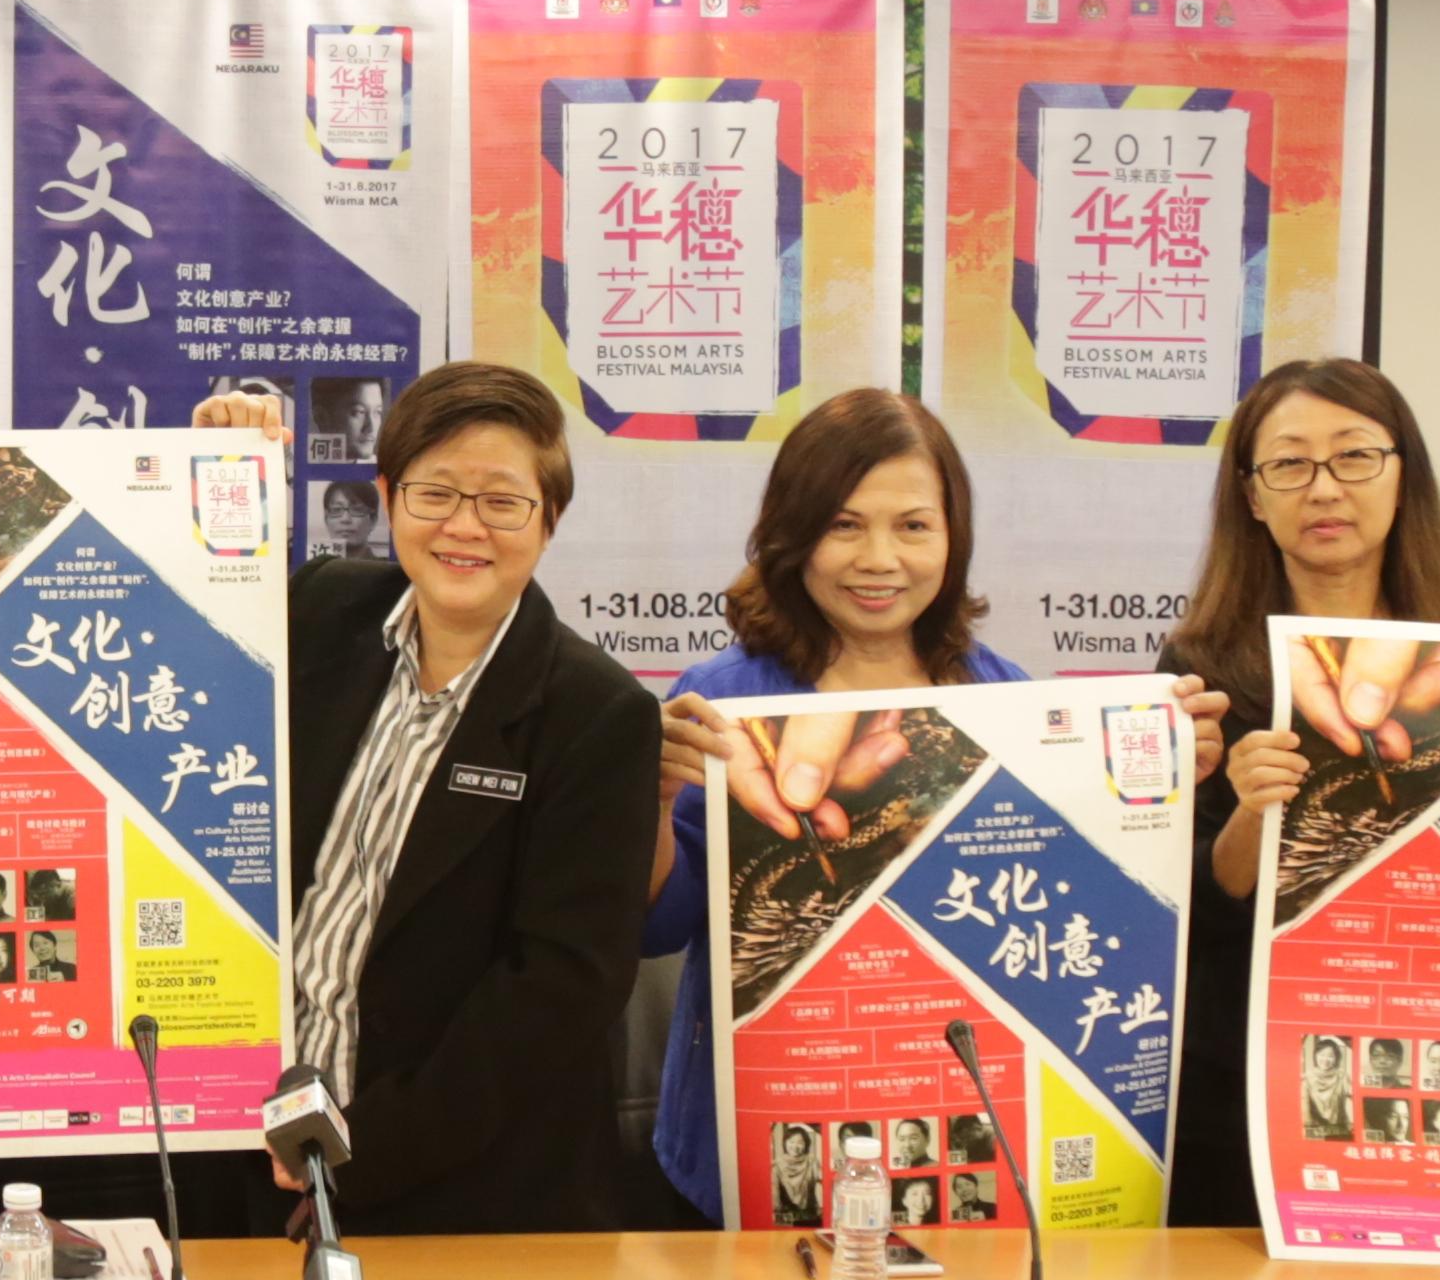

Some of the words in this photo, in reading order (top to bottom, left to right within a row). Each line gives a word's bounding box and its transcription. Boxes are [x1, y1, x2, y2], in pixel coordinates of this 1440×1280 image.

[328, 44, 391, 58] 2017
[216, 64, 280, 74] NEGARAKU
[329, 65, 388, 99] 华穗
[328, 100, 388, 124] 艺术节
[598, 127, 747, 159] 2017
[1071, 133, 1217, 167] 2017
[641, 162, 701, 178] 马来西亚
[1114, 169, 1173, 184] 马来西亚
[327, 182, 397, 192] 1-31.8.2017
[324, 195, 365, 206] Wisma
[369, 196, 398, 207] MCA
[598, 177, 744, 261] 华穗
[1070, 185, 1211, 268] 华穗
[176, 262, 212, 282] 何谓
[176, 290, 292, 308] 文化创意产业?
[597, 266, 744, 324] 艺术节
[1067, 271, 1210, 330] 艺术节
[597, 344, 687, 359] BLOSSOM
[696, 344, 744, 358] ARTS
[1064, 348, 1153, 363] BLOSSOM
[1163, 350, 1208, 364] ARTS
[597, 363, 665, 376] FESTIVAL
[670, 362, 743, 375] MALAYSIA
[1064, 366, 1131, 380] FESTIVAL
[1136, 368, 1206, 380] MALAYSIA
[205, 468, 250, 480] 2017
[126, 484, 172, 492] NEGARAKU
[208, 483, 250, 507] 华穗
[580, 591, 727, 618] 1-31.08.20
[1040, 593, 1190, 619] 1-31.08.20
[596, 631, 680, 652] Wisma
[1053, 631, 1136, 653] Wisma
[161, 741, 269, 814] 产业
[456, 772, 481, 786] CHEW
[482, 776, 498, 789] MEI
[500, 778, 518, 792] FUN
[233, 802, 271, 817] 研讨会
[205, 845, 271, 859] 24-25.6.2017
[136, 976, 185, 989] 03-2203
[187, 975, 216, 987] 3979
[1075, 983, 1169, 1056] 产业
